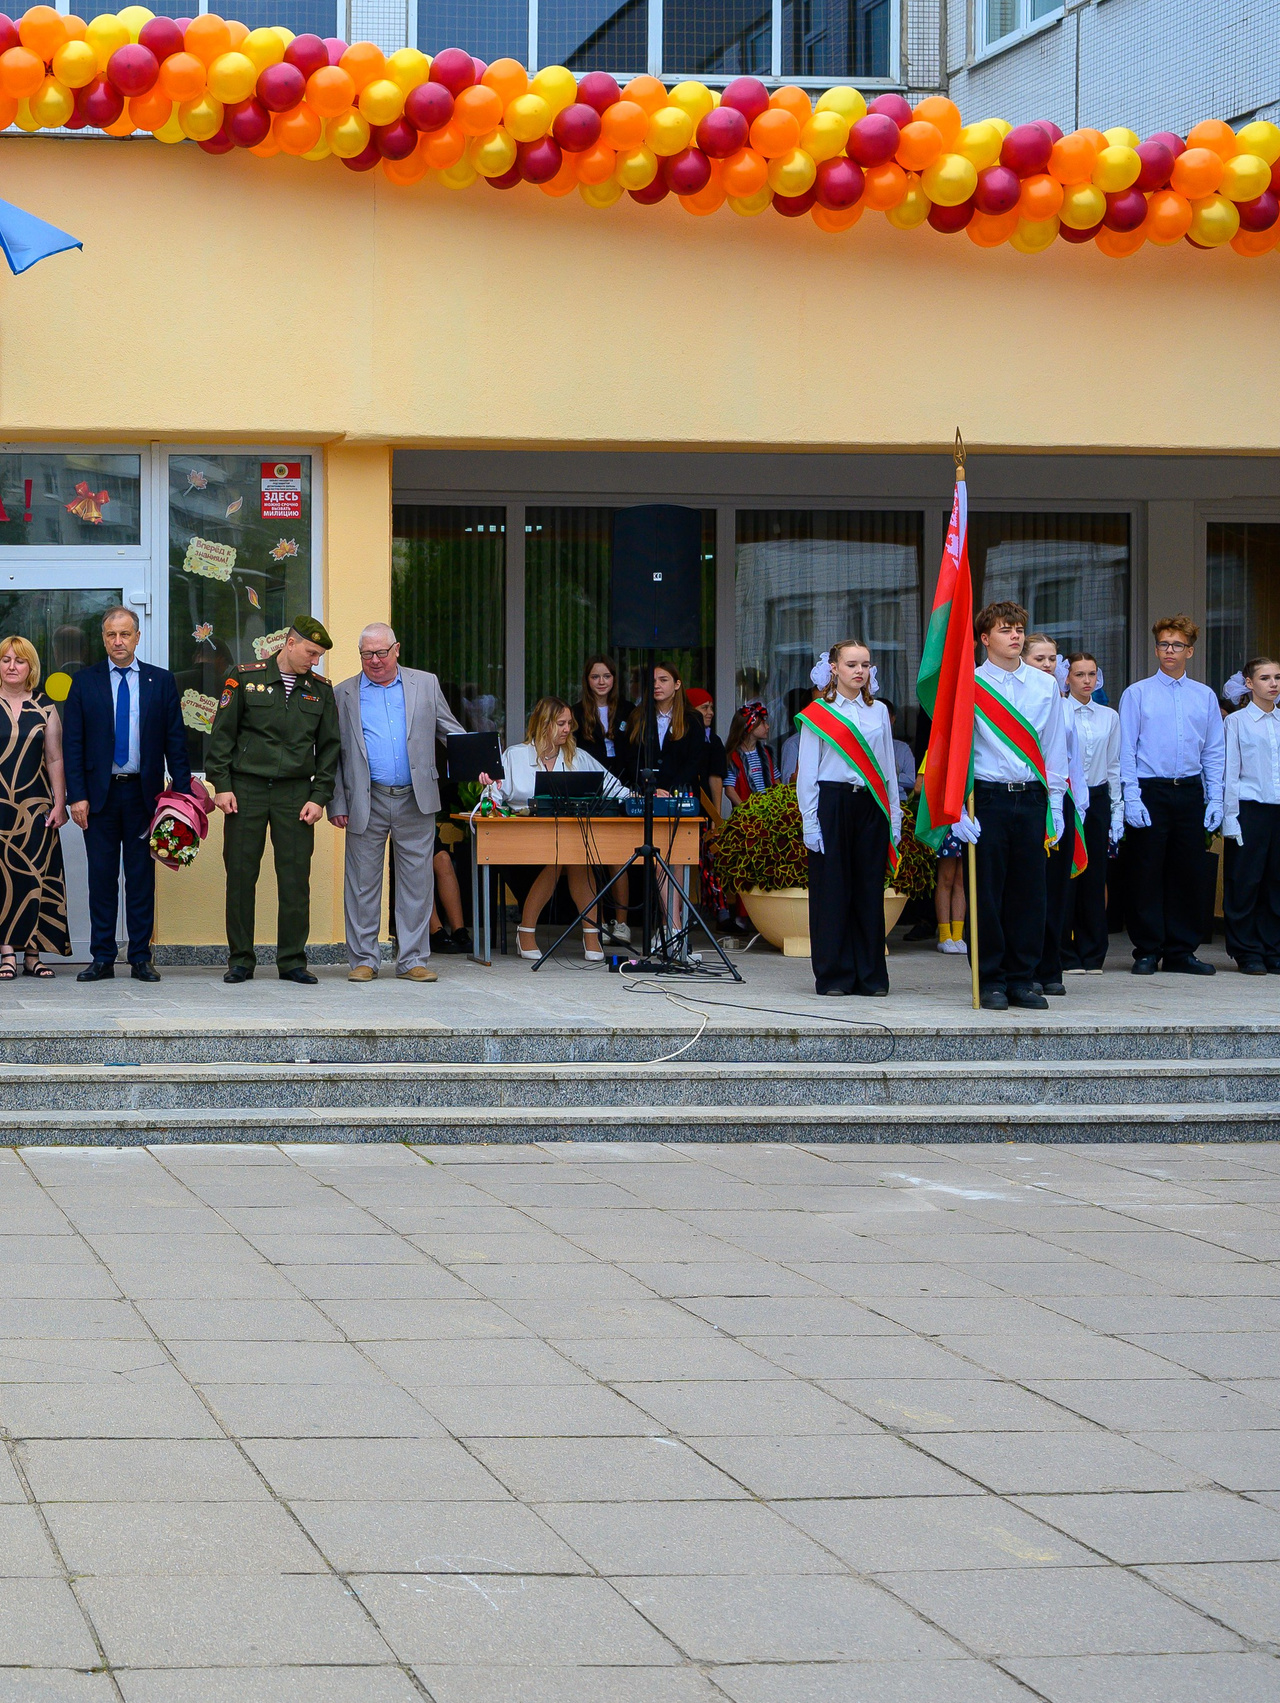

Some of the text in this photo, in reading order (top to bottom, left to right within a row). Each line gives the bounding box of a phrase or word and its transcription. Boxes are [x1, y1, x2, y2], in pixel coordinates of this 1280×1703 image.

[263, 492, 299, 503] ЗДЕСЬ
[195, 540, 225, 555] Вперёд
[194, 550, 229, 565] знаниям!
[270, 643, 285, 652] шко
[199, 695, 216, 707] Буду
